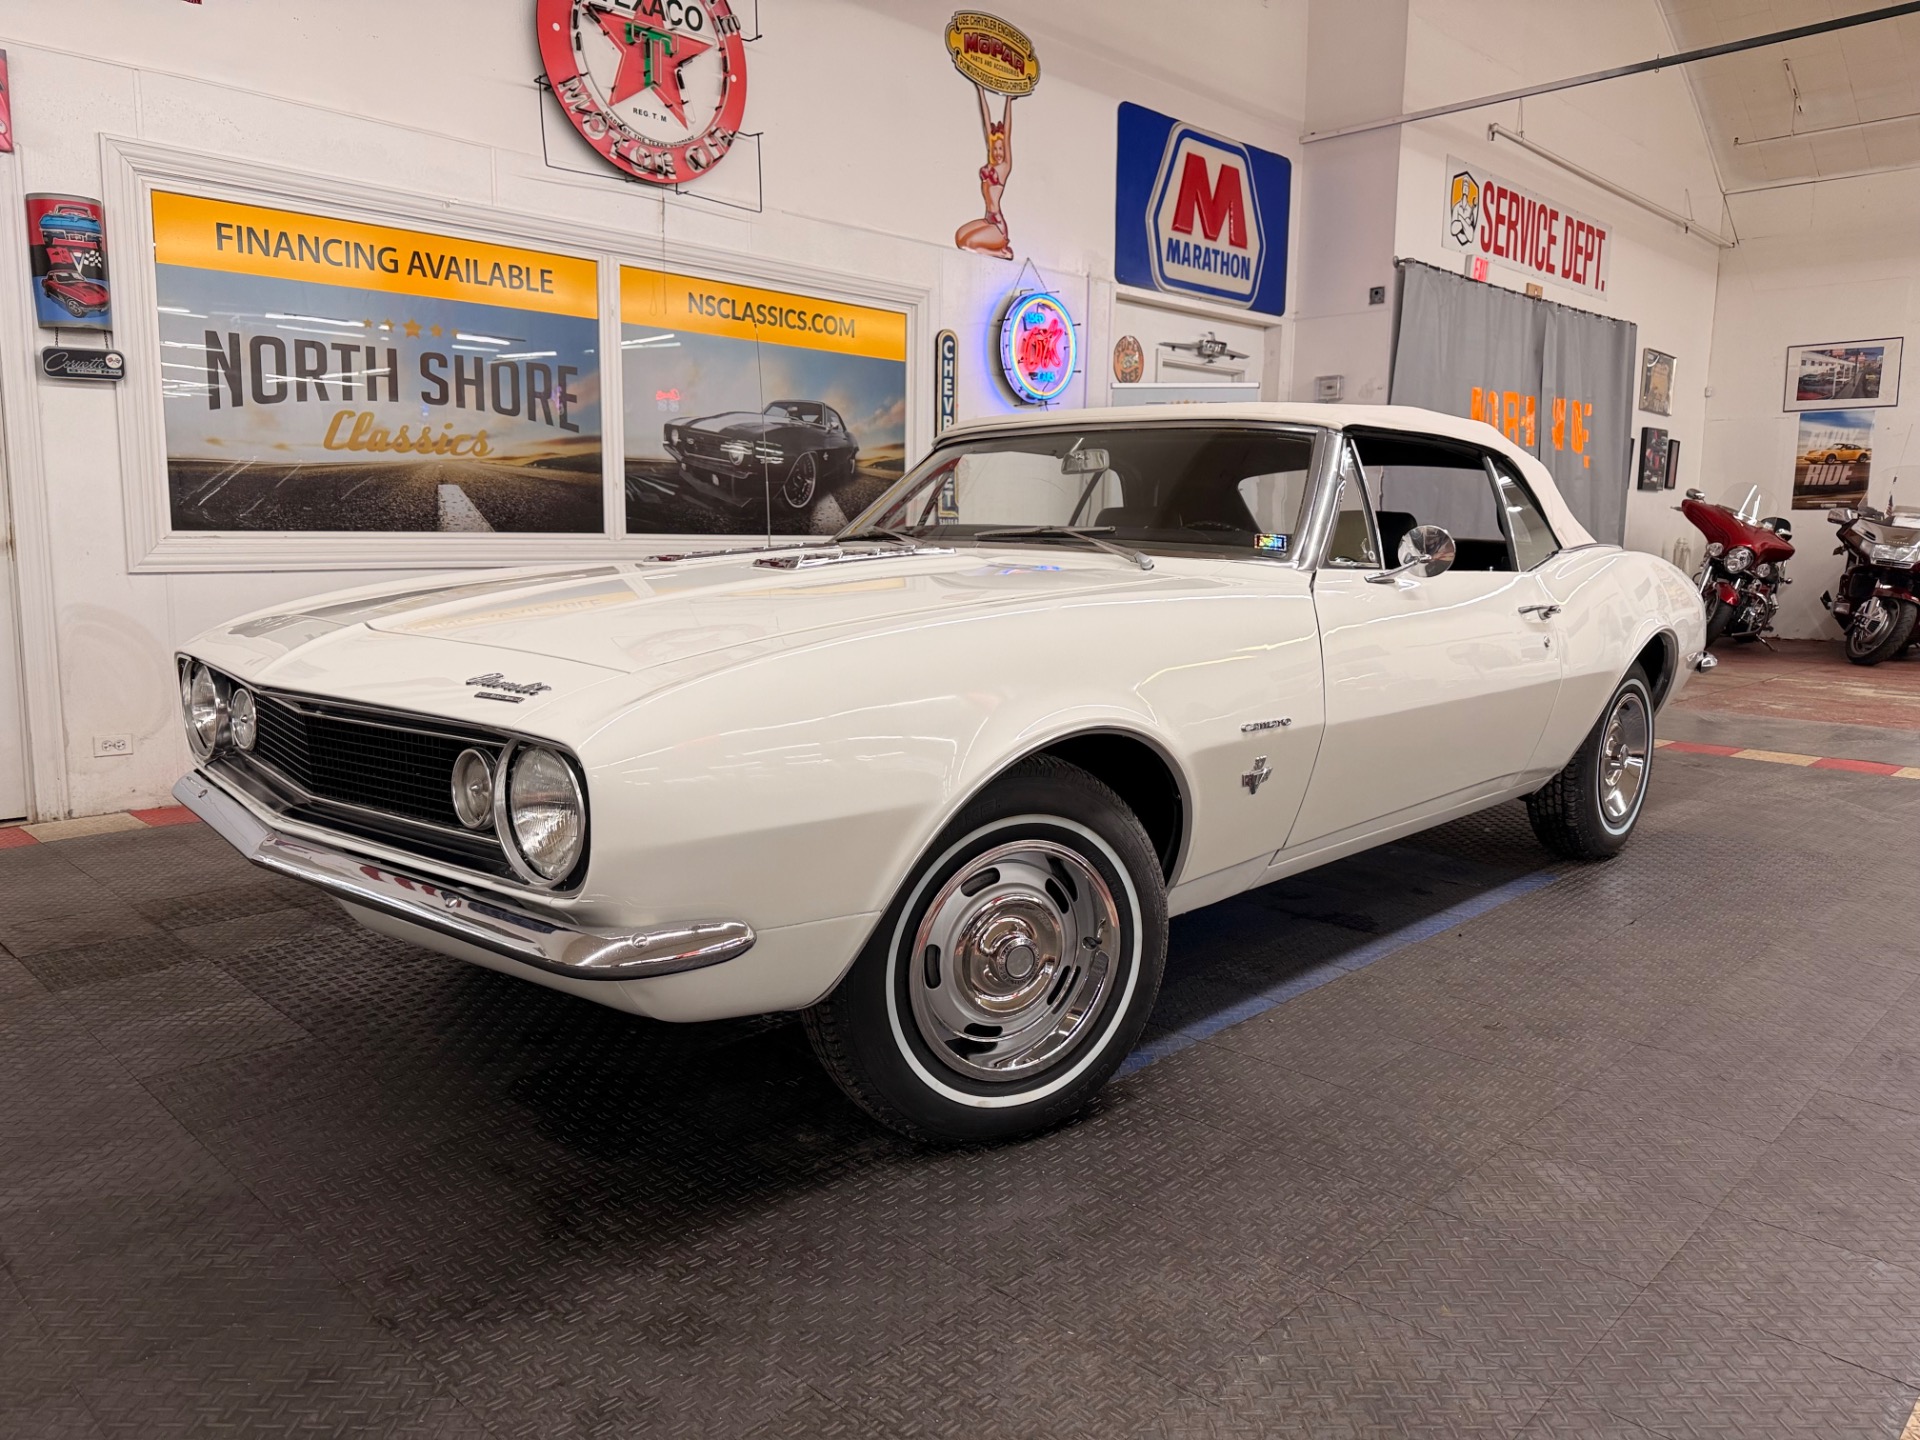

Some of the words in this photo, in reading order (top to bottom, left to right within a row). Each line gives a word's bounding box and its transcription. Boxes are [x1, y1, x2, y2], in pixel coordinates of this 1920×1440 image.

[958, 15, 969, 25] USE
[970, 15, 997, 31] CHRYSLER
[997, 23, 1029, 51] ENGINEERED
[964, 32, 1025, 76] MOPAR
[970, 54, 983, 65] PARTS
[984, 59, 993, 68] AND
[993, 63, 1020, 78] ACCESSORIES
[634, 133, 647, 143] THE
[1172, 152, 1248, 250] M
[1480, 180, 1559, 274] SERVICE
[1560, 215, 1606, 292] DEPT.
[215, 222, 399, 274] FINANCING
[406, 251, 554, 295] AVAILABLE
[1166, 238, 1251, 281] MARATHON
[687, 291, 856, 339] NSCLASSICS.COM
[45, 352, 107, 372] Corvette
[205, 329, 400, 411] NORTH
[419, 351, 581, 434] SHORE
[323, 409, 496, 458] Classics
[1804, 464, 1853, 486] RIDE
